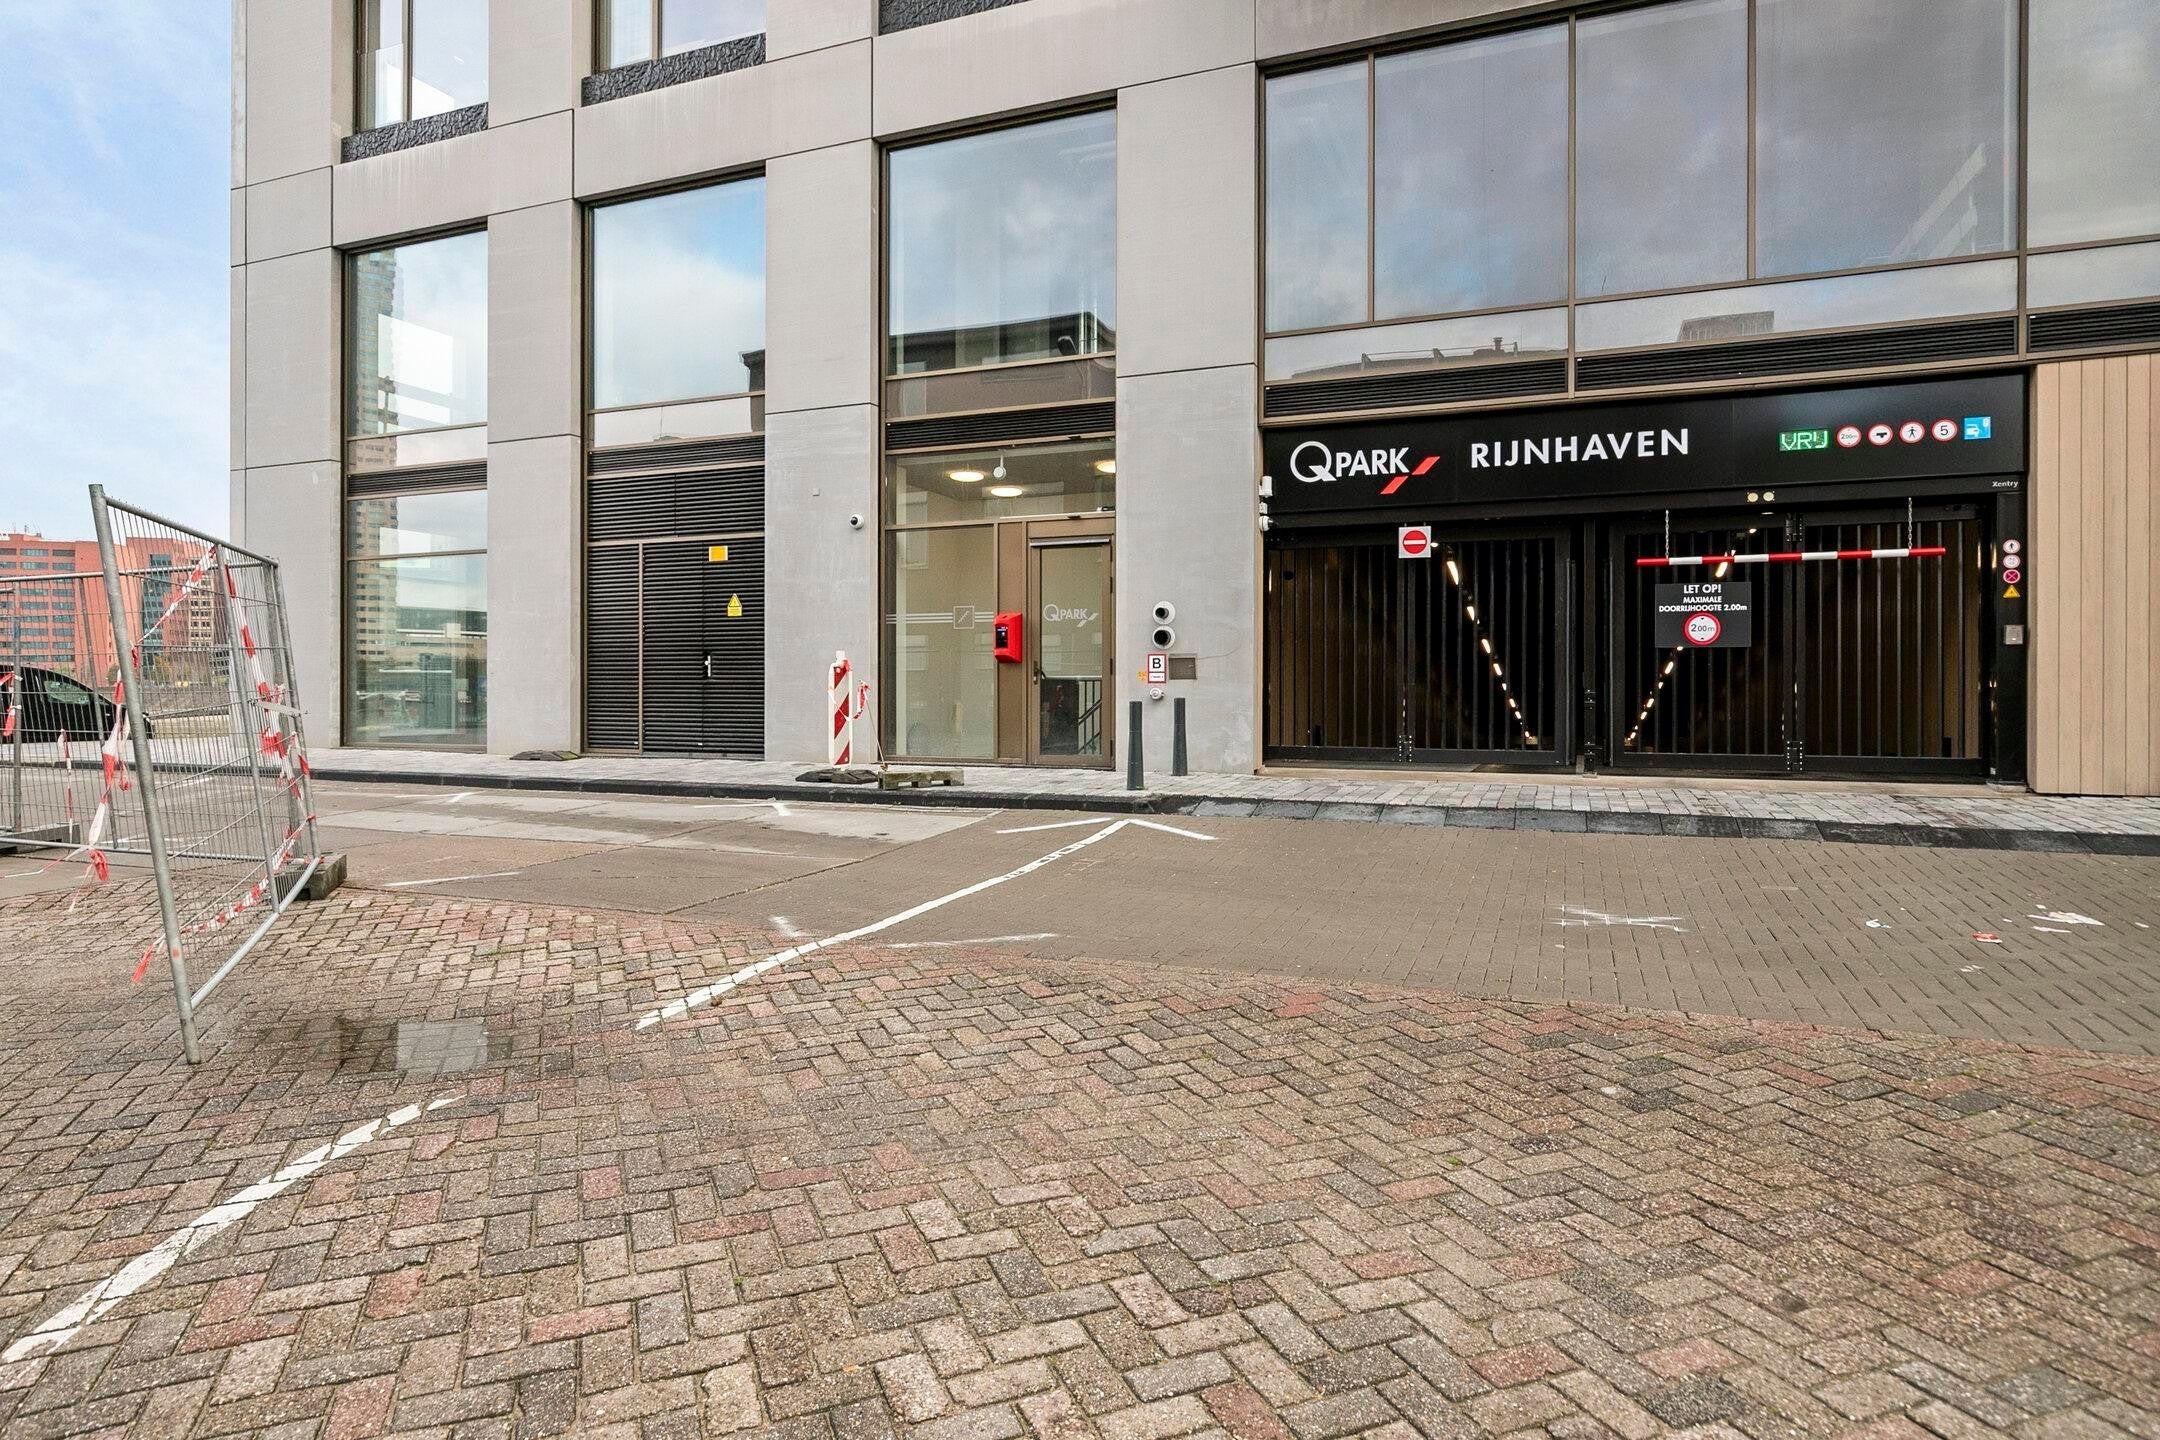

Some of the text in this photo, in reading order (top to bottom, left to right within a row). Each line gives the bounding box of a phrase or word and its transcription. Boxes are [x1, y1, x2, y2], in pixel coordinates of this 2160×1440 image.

[1940, 425, 1949, 436] 5
[1471, 428, 1689, 469] RIJNHAVEN
[1683, 584, 1722, 594] LET OP!
[1683, 596, 1722, 604] MAXIMALE
[1659, 604, 1722, 612] DOORRIJHOOGTE
[1152, 657, 1162, 669] B
